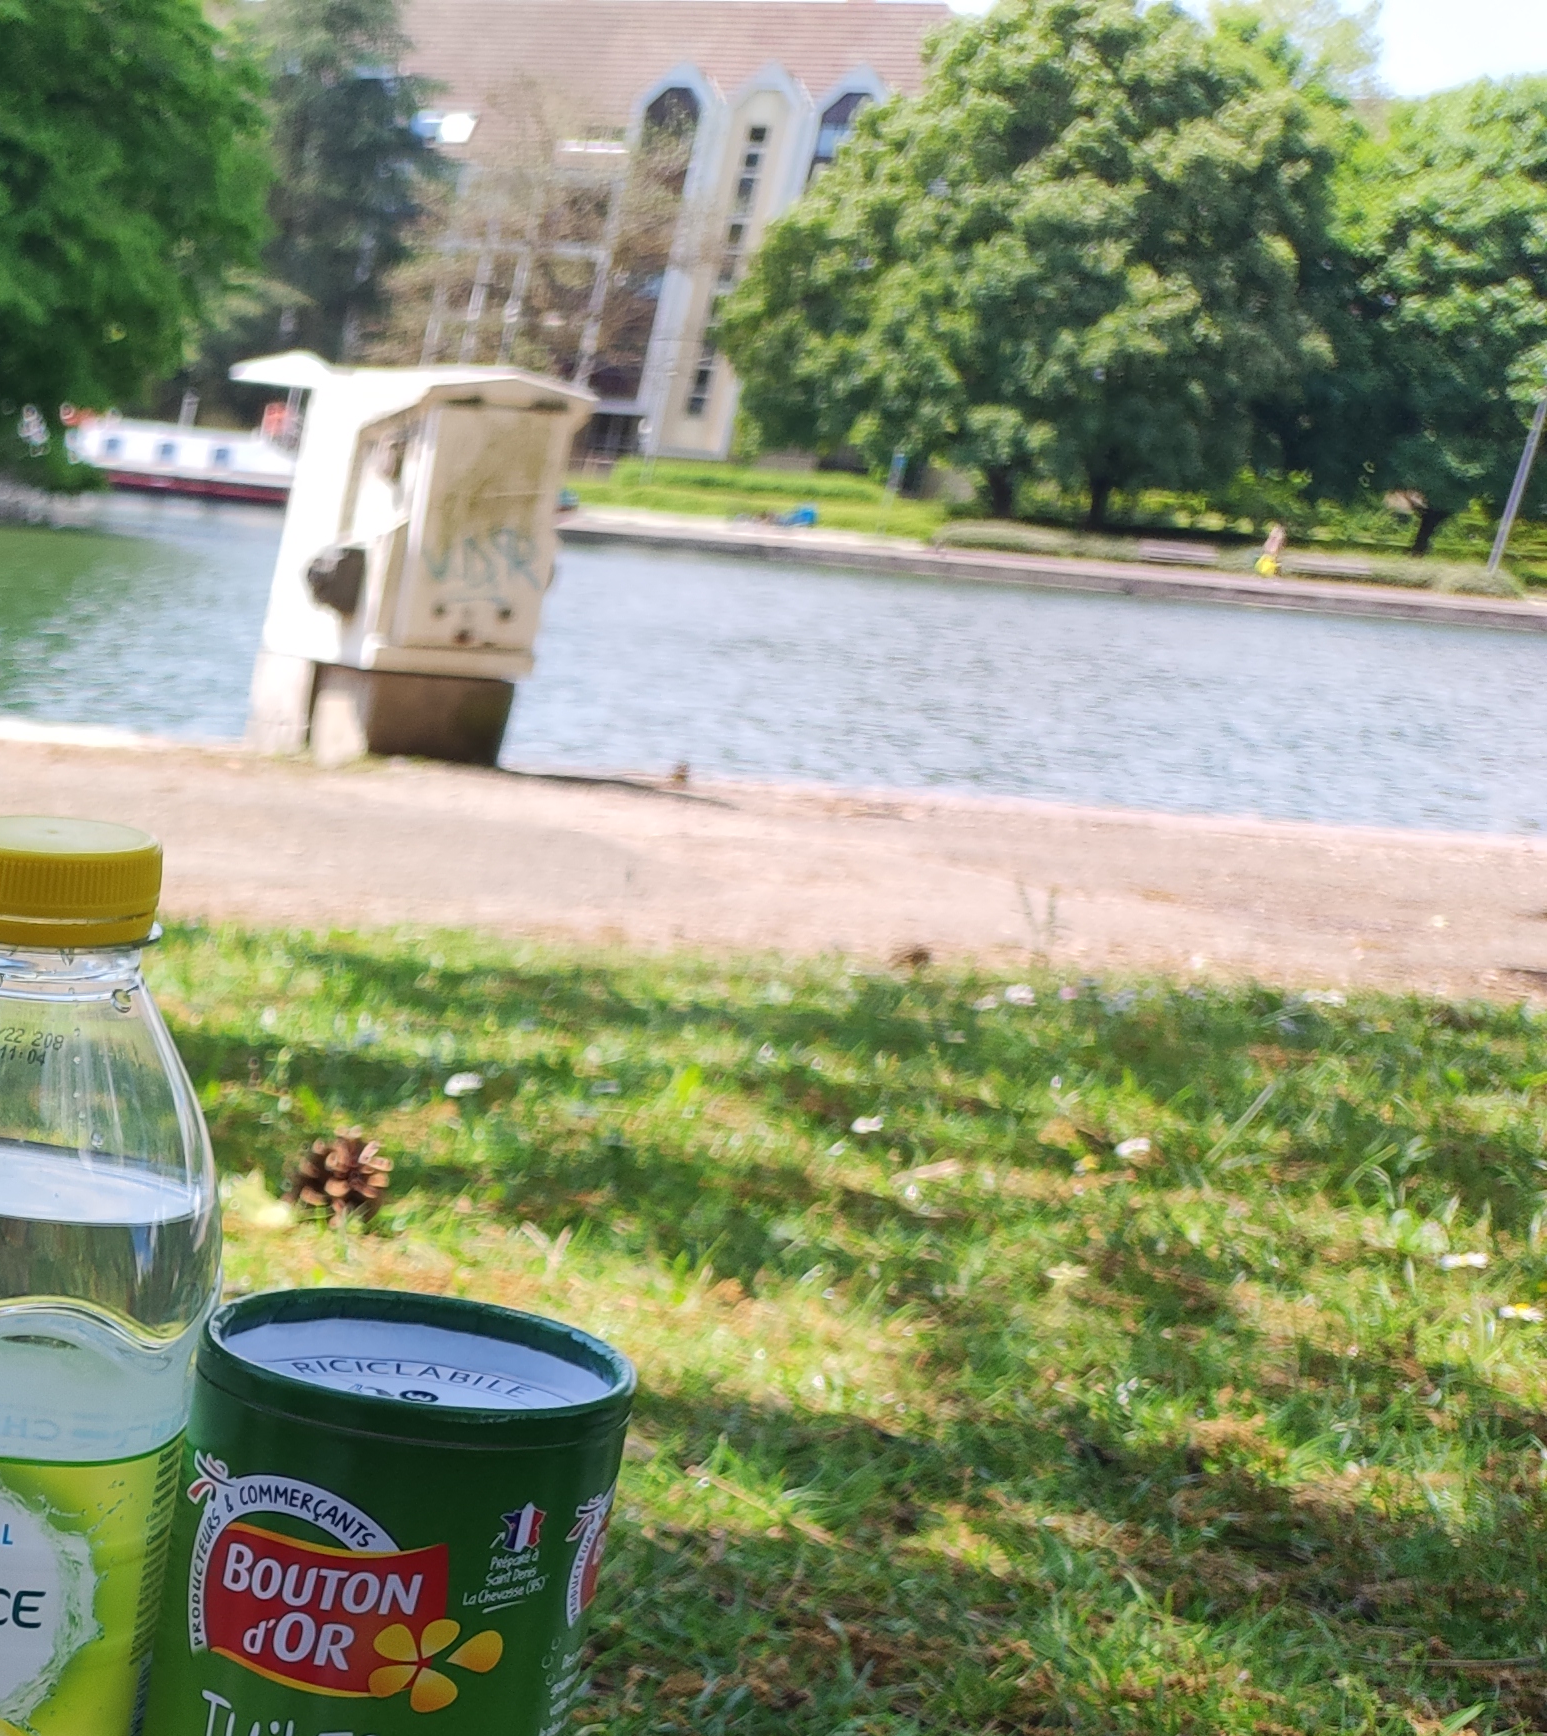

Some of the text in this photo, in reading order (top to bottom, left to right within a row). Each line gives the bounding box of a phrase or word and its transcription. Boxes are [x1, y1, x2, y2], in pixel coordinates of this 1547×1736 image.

[291, 1358, 532, 1399] RICICLABILE
[193, 1484, 377, 1647] PRODUCTEURS & COMMERÇANTS
[222, 1542, 423, 1616] BOUTON
[462, 1592, 476, 1606] La
[242, 1611, 355, 1671] d'OR
